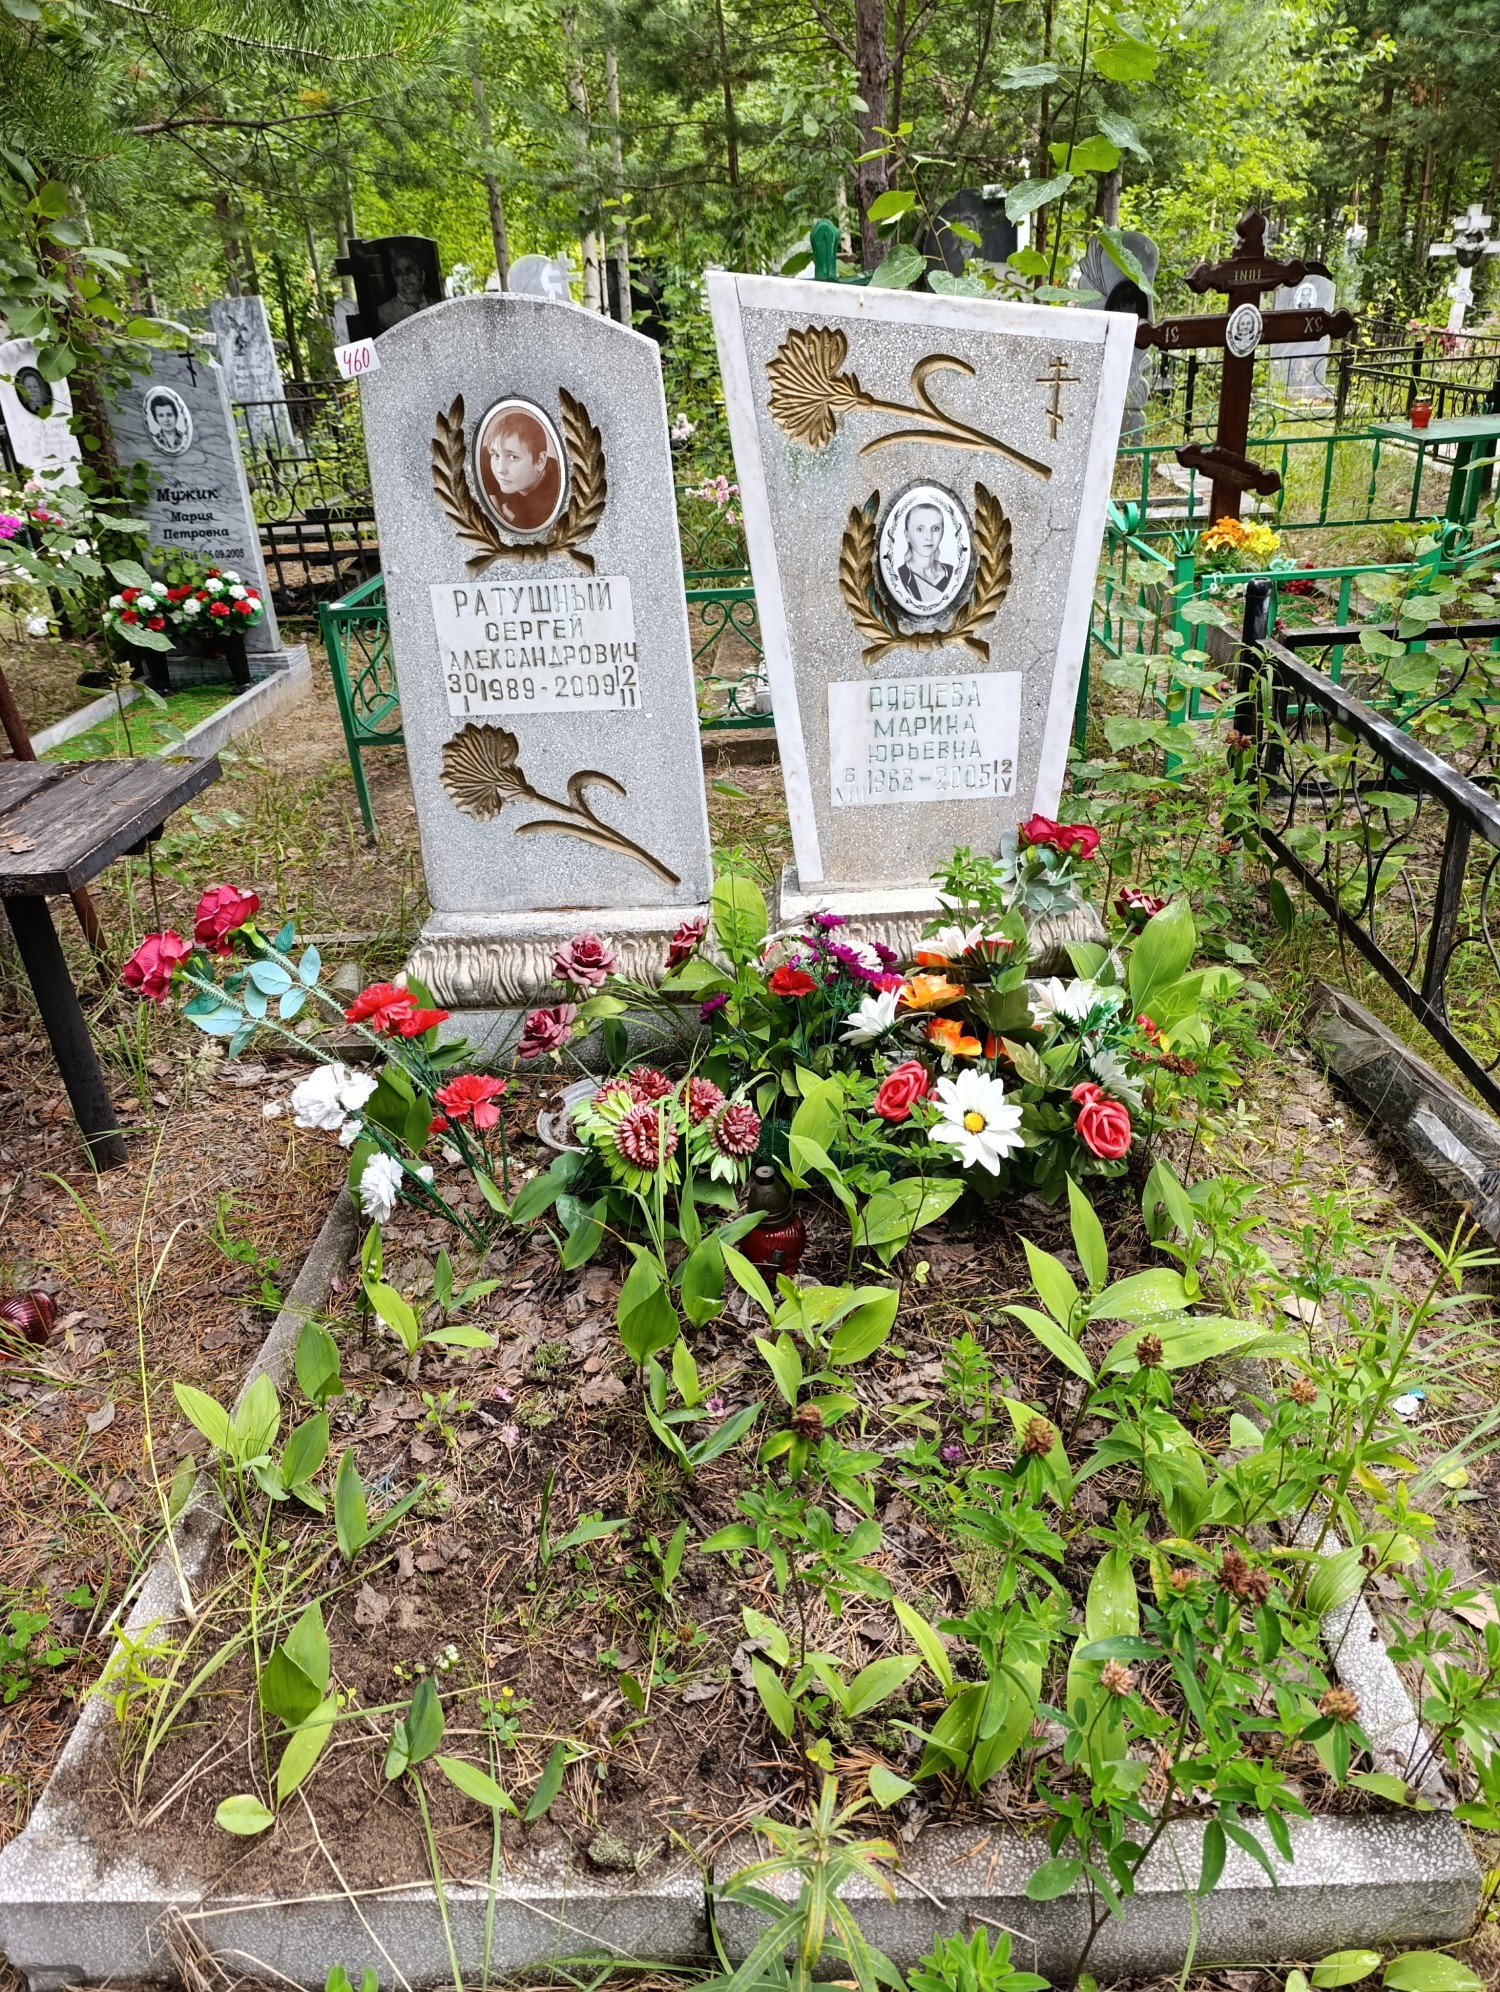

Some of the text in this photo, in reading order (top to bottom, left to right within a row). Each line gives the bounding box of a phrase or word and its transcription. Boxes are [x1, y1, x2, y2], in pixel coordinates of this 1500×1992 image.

[343, 346, 370, 375] 460
[156, 488, 219, 505] Мужик
[171, 511, 214, 524] Мария
[163, 528, 230, 541] Петровна
[452, 578, 613, 618] РАТУШНЫЙ
[485, 613, 584, 643] СЕРГЕЙ
[449, 642, 640, 672] АЛЕКСАНДРОВИЧ
[869, 680, 981, 713] РЯБЦЕВА
[873, 713, 977, 739] МАРИНА
[868, 738, 982, 764] ЮРЬЕВНА
